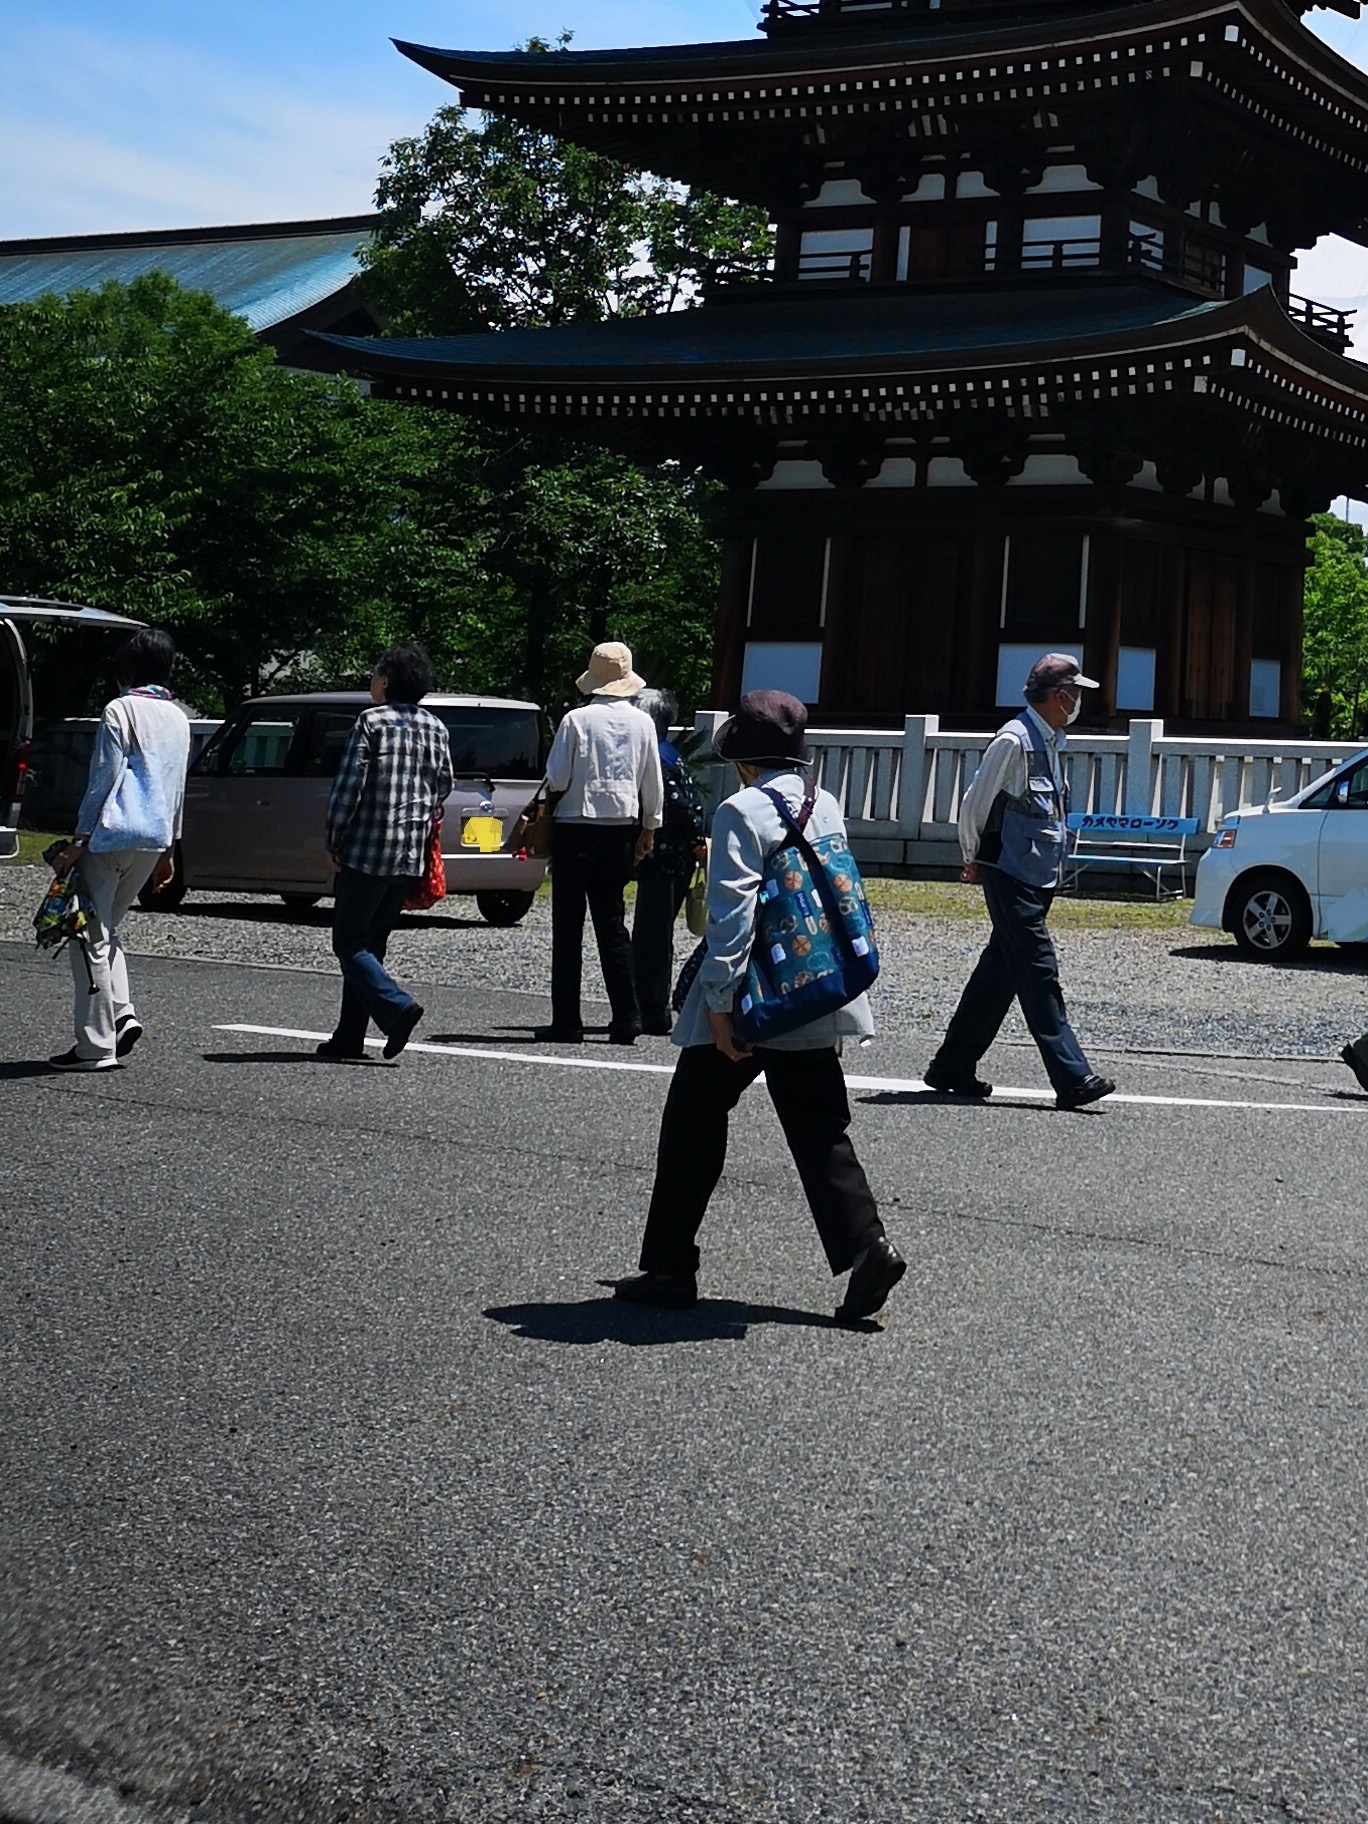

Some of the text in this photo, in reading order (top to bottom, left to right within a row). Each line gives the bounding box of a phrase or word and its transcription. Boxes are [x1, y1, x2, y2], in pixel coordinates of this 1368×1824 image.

[1082, 816, 1179, 830] カメヤマローソク
